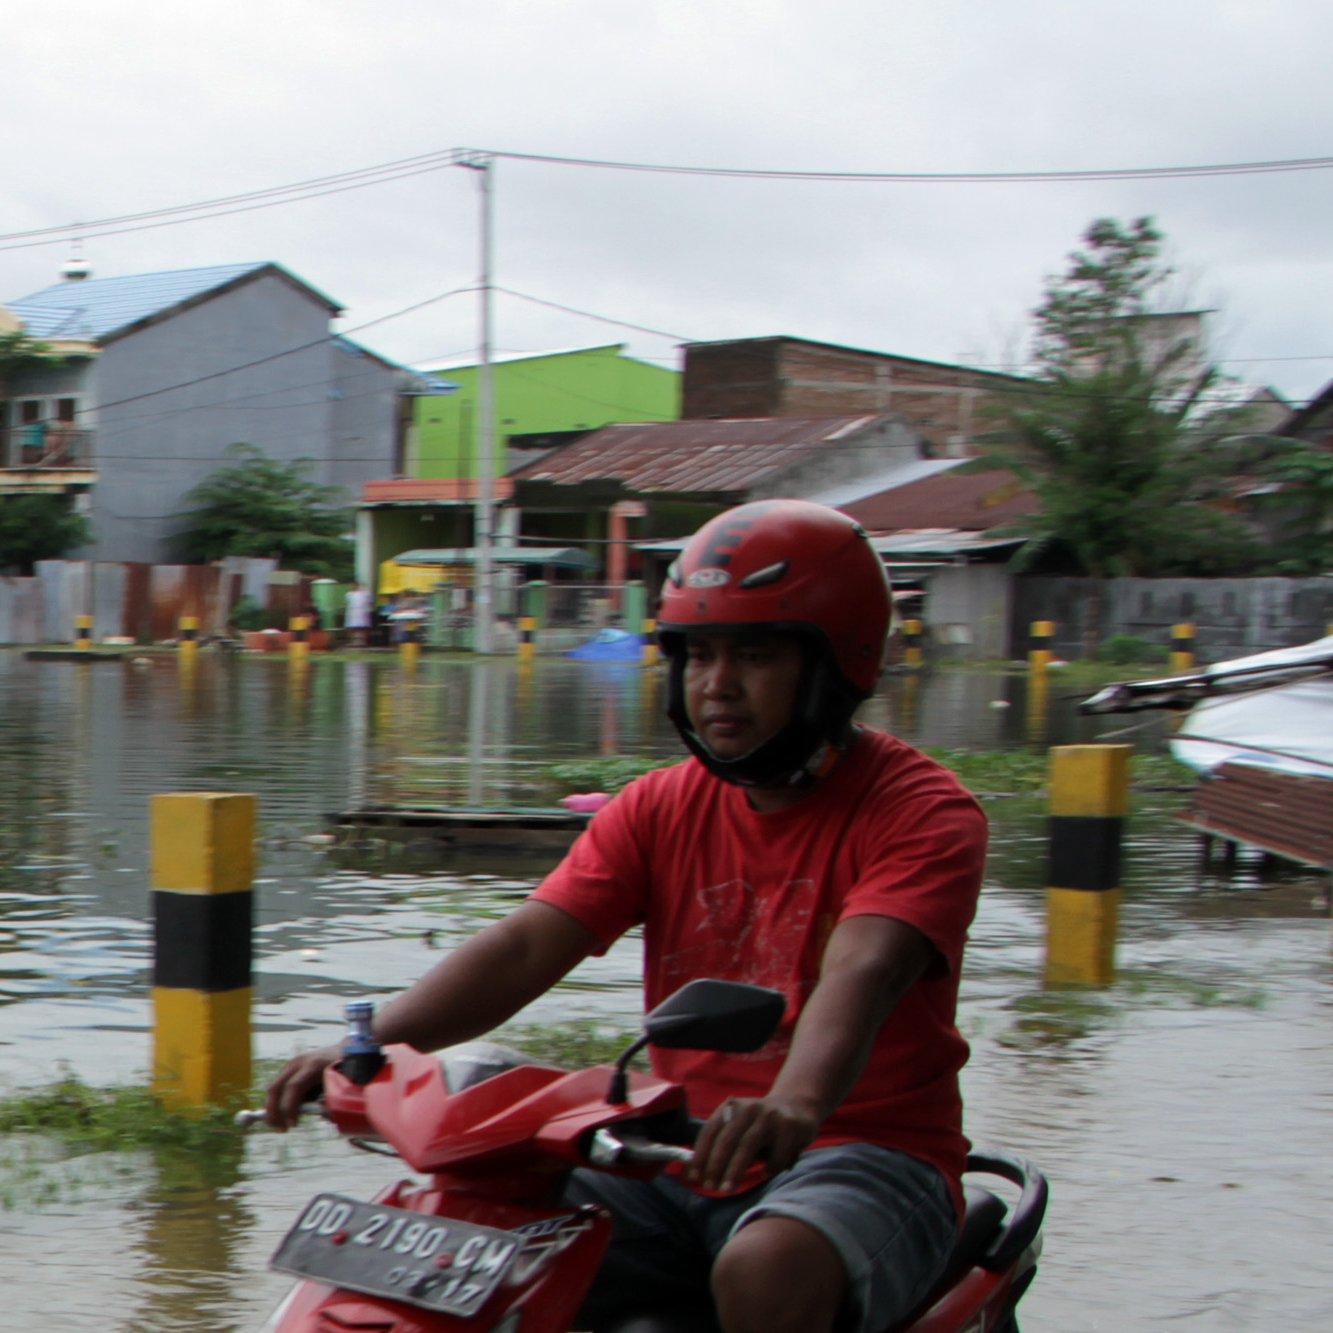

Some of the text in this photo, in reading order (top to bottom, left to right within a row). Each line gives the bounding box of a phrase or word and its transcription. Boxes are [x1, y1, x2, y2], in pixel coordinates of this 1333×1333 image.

[300, 1200, 516, 1276] DD 2190 CM
